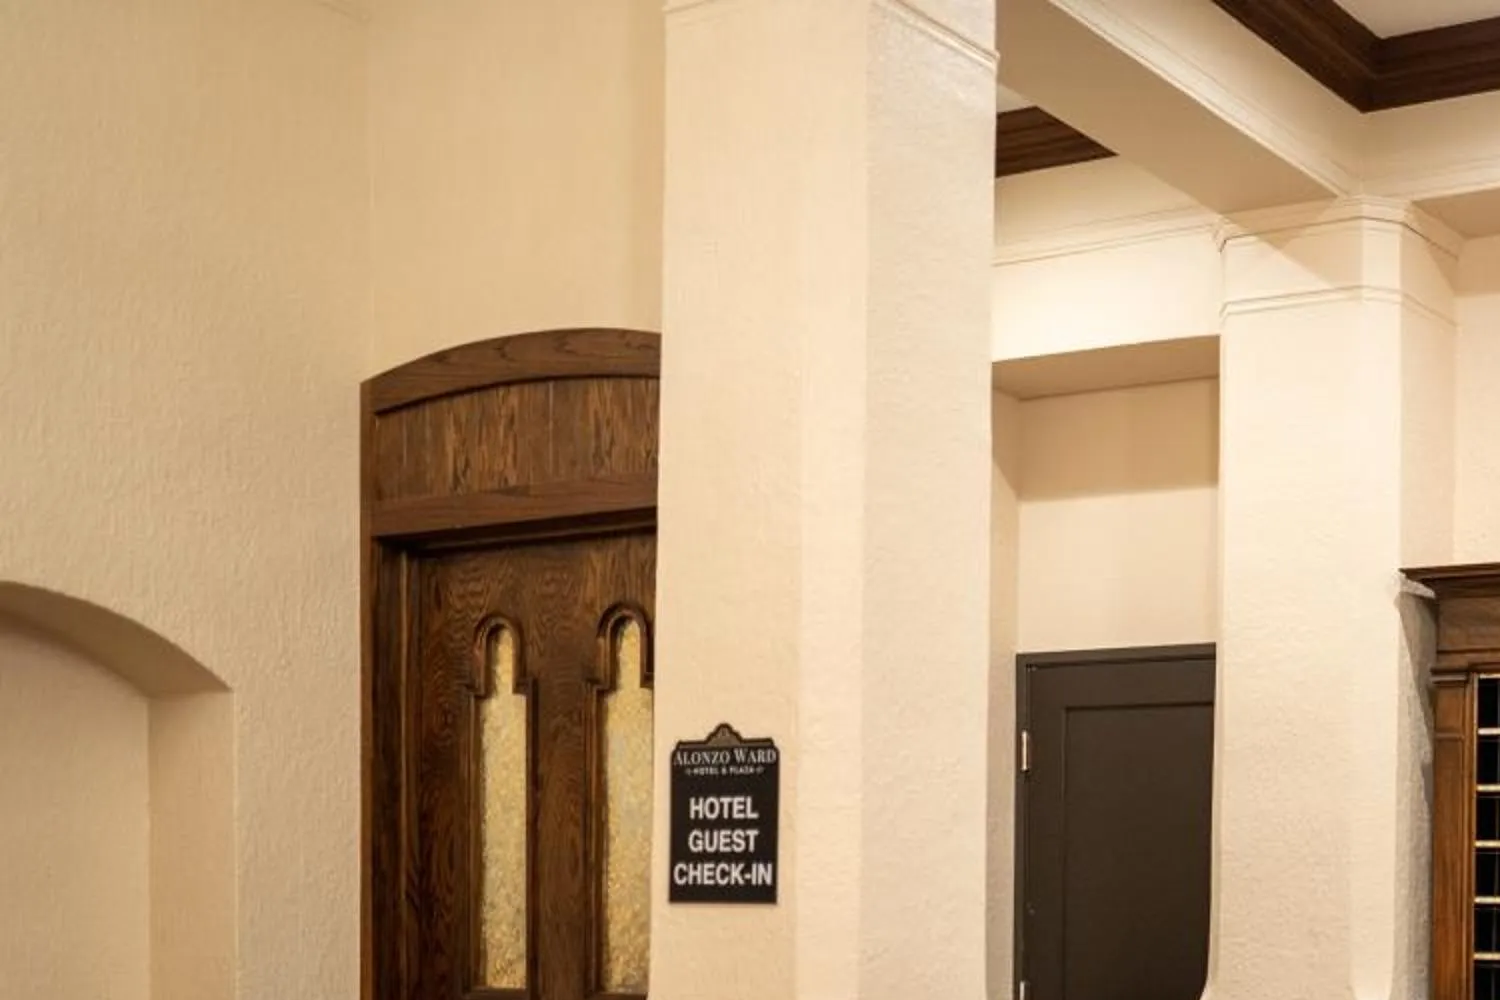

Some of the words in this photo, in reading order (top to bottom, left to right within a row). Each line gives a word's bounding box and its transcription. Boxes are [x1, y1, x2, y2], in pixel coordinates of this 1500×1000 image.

[674, 750, 731, 766] ALONZO
[733, 747, 777, 765] WARD
[689, 797, 759, 820] HOTEL
[688, 829, 759, 853] GUEST
[673, 862, 773, 886] CHECK-IN
